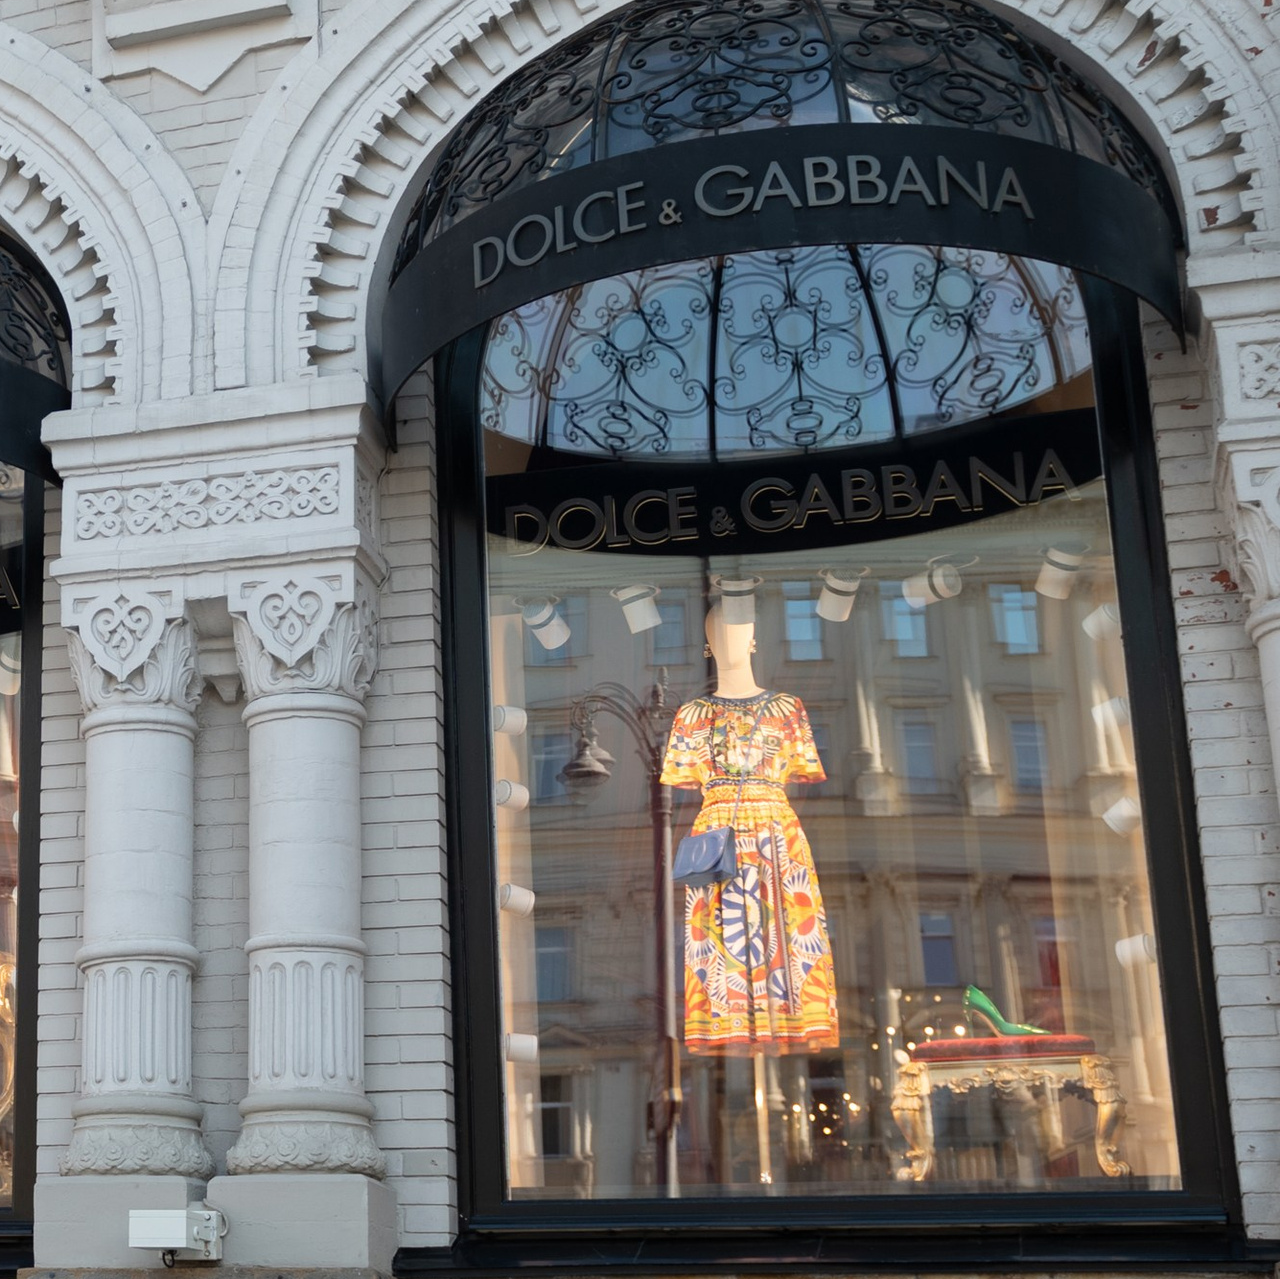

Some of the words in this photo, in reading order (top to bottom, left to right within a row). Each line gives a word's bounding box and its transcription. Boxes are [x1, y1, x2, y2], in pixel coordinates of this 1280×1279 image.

[473, 181, 647, 289] DOLCE
[658, 198, 682, 225] &
[694, 154, 1035, 220] GABBANA
[505, 486, 699, 556] DOLCE
[709, 505, 737, 536] &
[739, 448, 1082, 532] GABBANA
